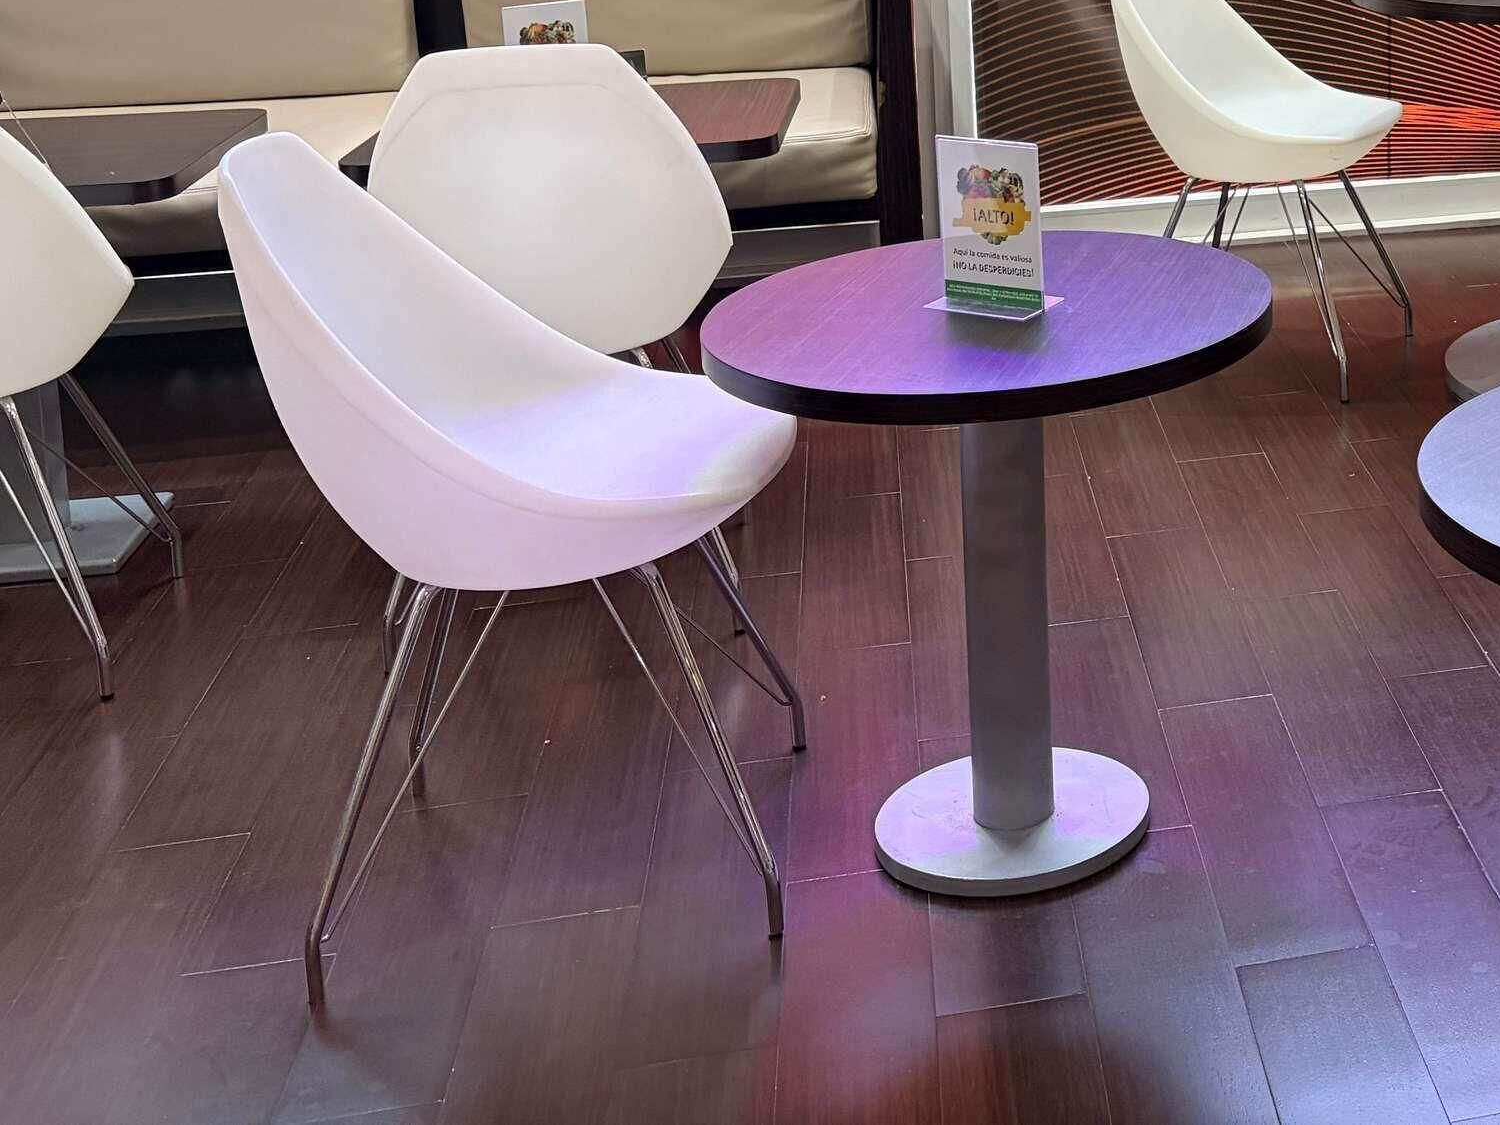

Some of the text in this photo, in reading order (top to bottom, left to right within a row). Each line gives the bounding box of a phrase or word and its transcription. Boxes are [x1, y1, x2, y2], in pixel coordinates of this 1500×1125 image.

[976, 251, 1000, 260] comida
[1010, 255, 1033, 264] valiosa
[968, 262, 978, 271] LA
